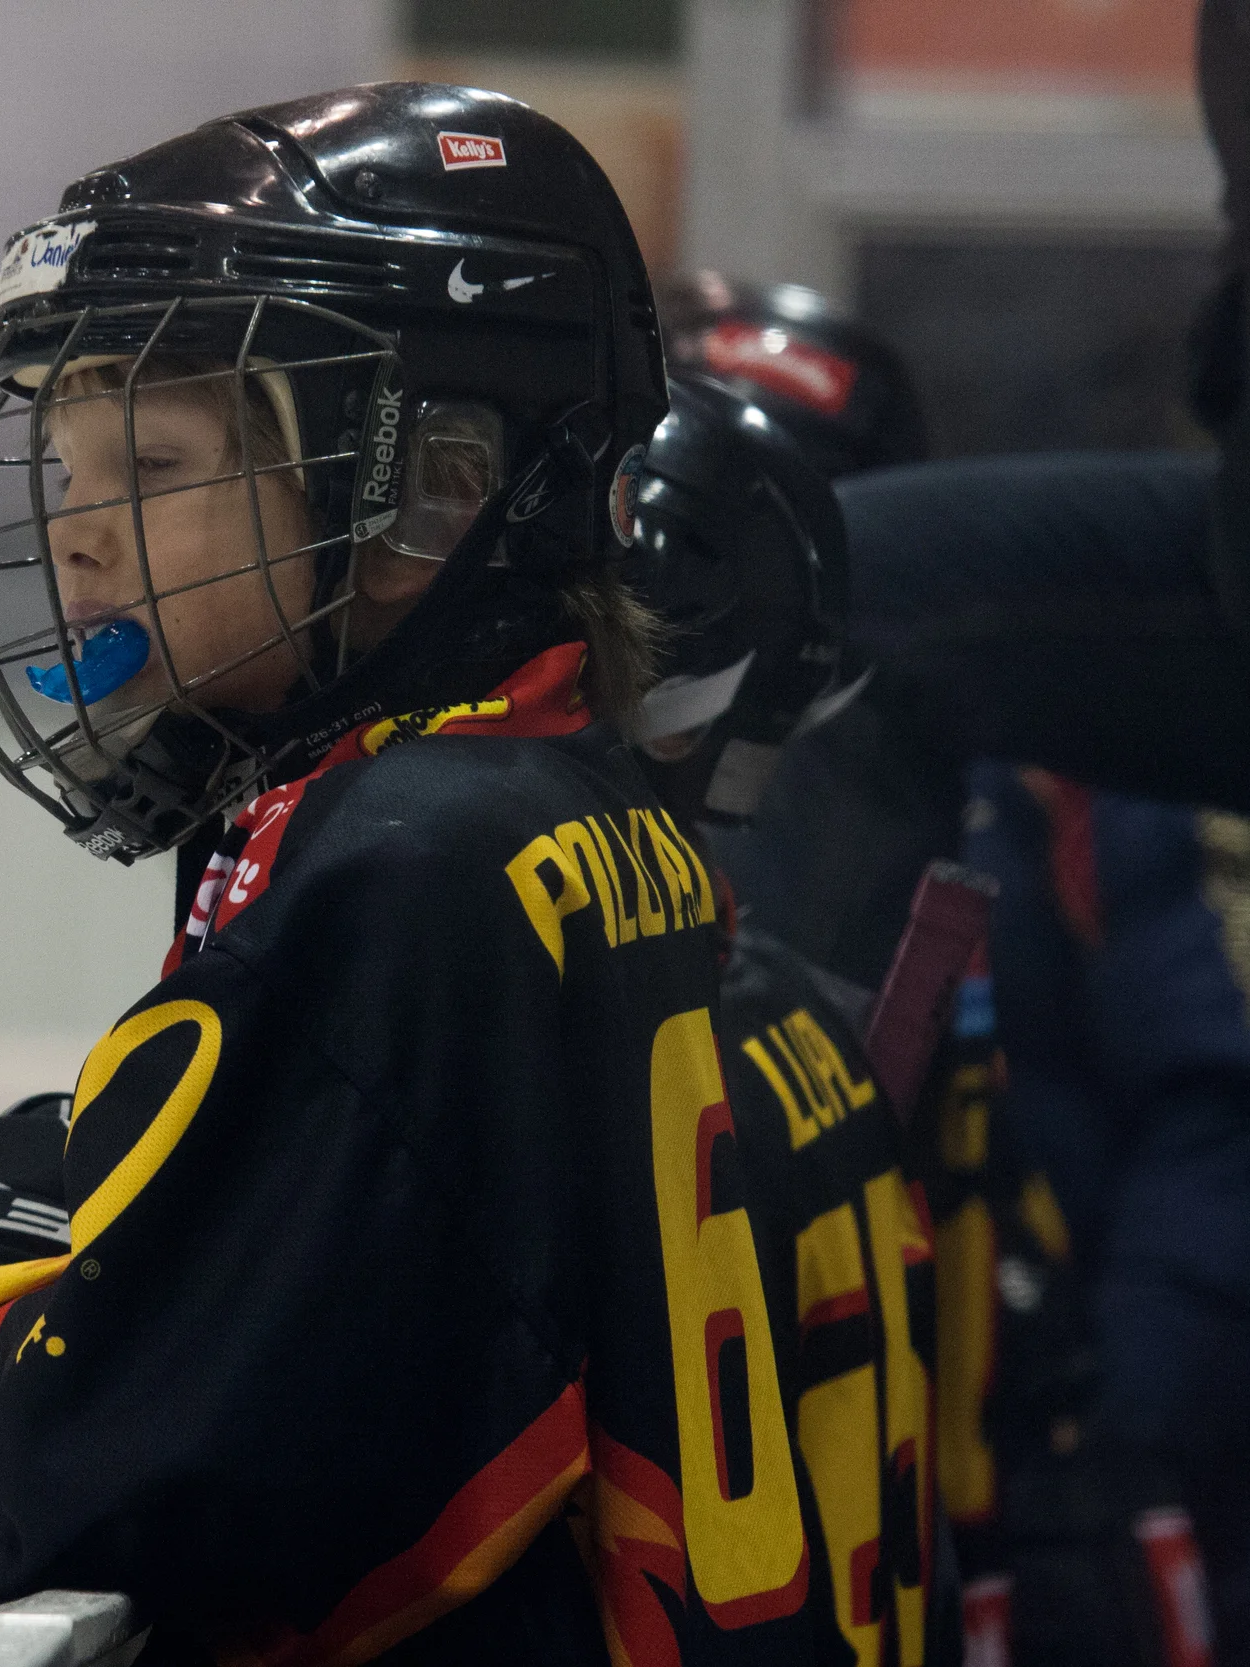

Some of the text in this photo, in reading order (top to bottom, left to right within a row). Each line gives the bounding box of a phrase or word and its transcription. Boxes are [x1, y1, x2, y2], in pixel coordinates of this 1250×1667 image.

[445, 138, 495, 160] Kelly's
[362, 386, 404, 504] Reebok
[353, 701, 383, 722] cm)
[649, 1006, 809, 1630] 6
